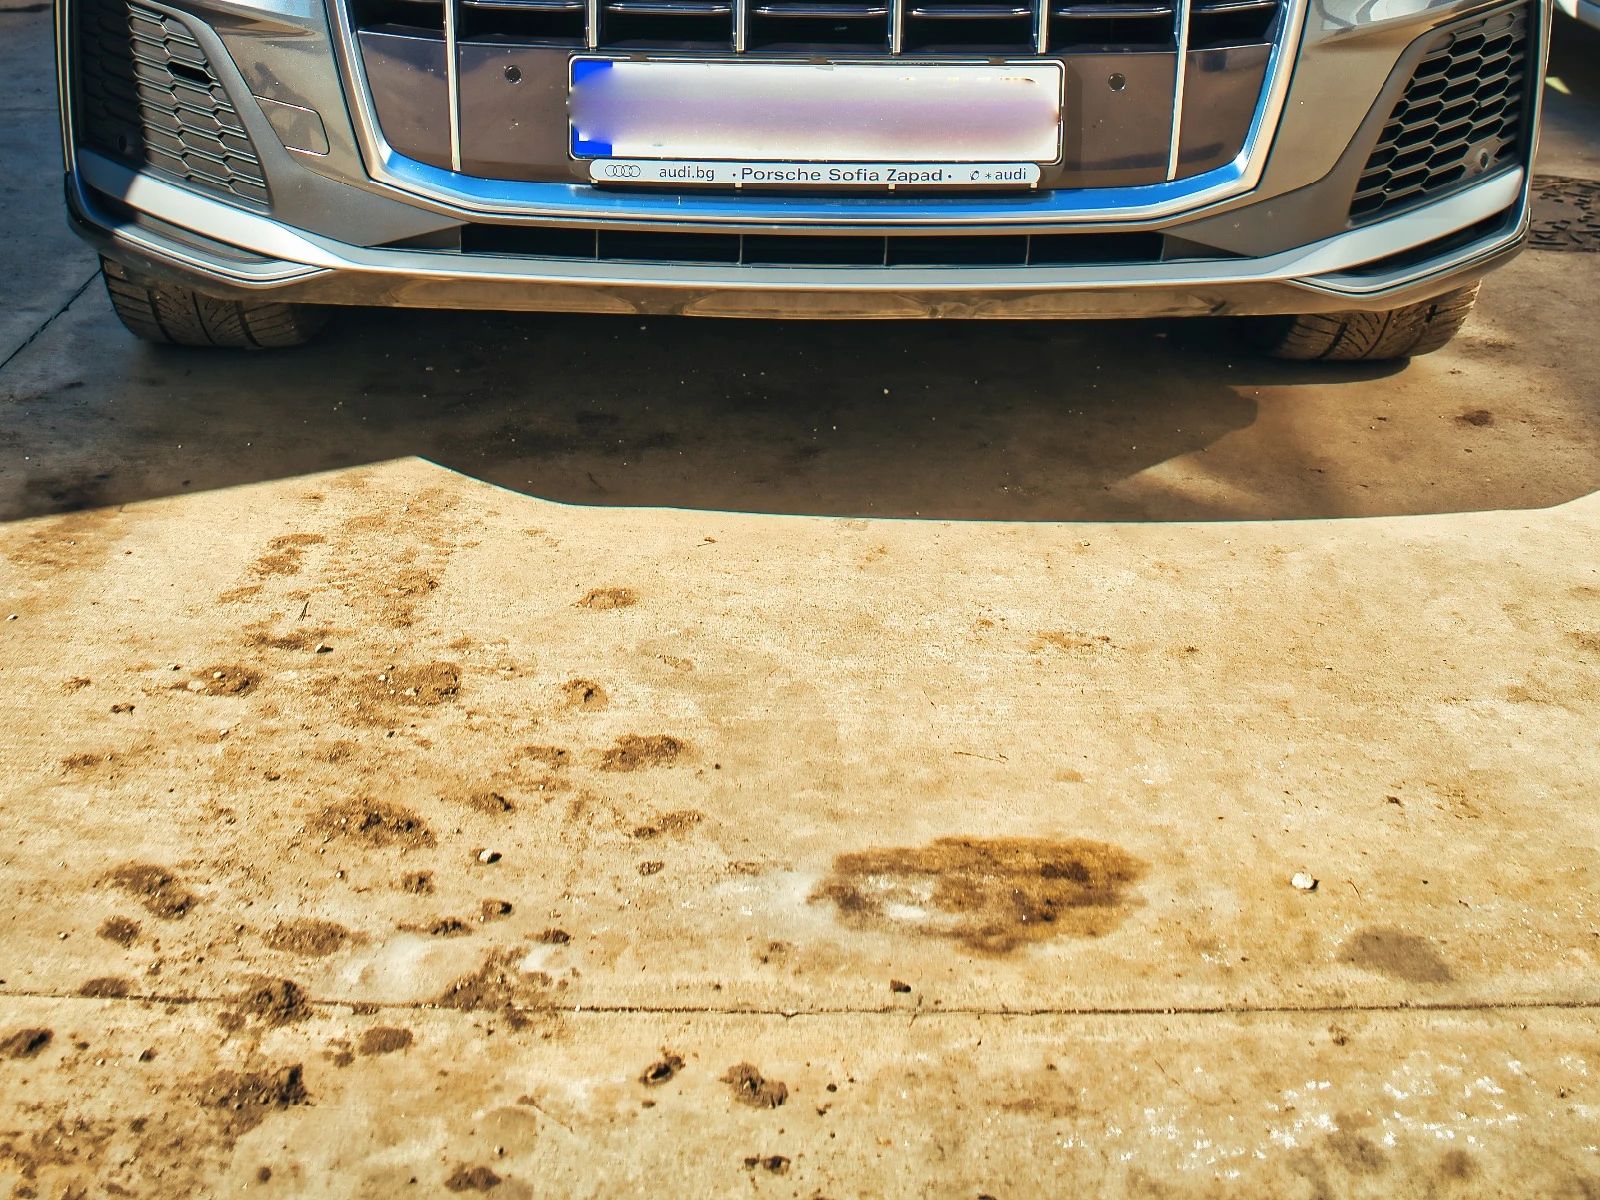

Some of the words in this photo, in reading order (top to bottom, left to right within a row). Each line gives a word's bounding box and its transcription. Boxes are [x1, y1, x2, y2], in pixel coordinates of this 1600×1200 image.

[659, 165, 715, 181] audi.bg
[741, 167, 821, 181] Porsche
[828, 168, 880, 181] Sofia
[886, 168, 943, 183] Zapad
